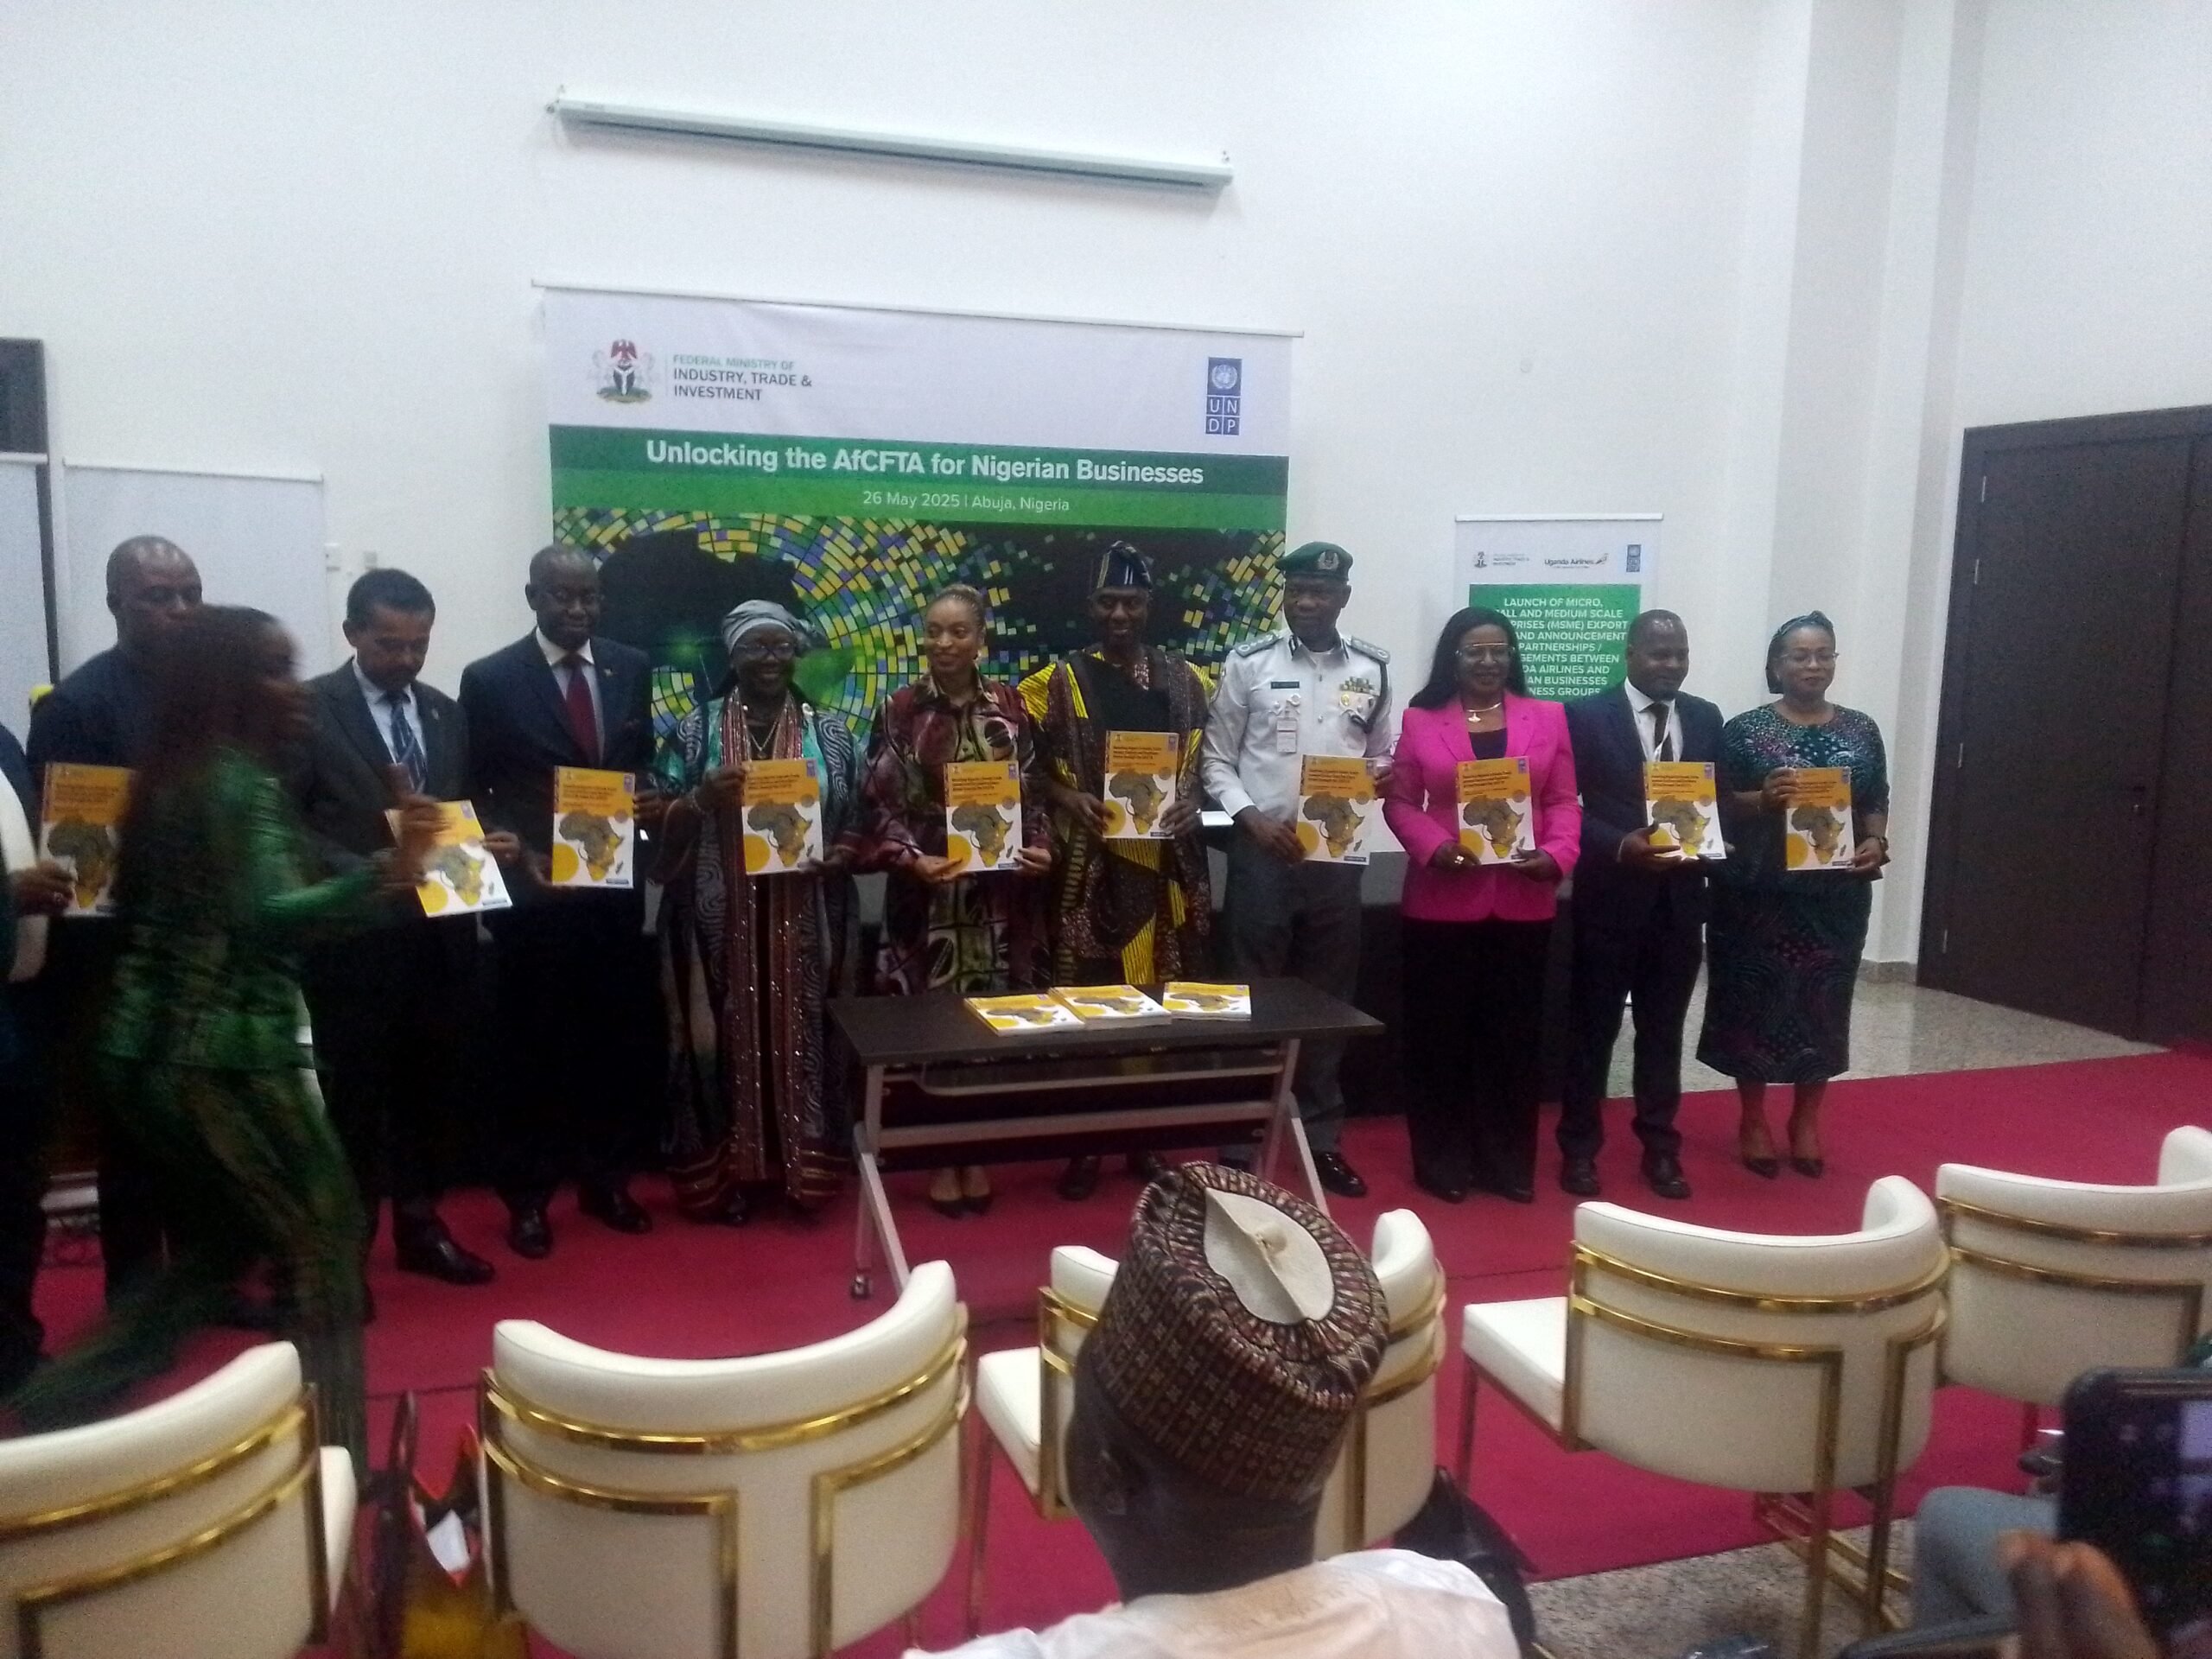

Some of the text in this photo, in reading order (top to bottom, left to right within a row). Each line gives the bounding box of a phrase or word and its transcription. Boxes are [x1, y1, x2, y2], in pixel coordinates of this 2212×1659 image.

[673, 354, 795, 371] FEDERAL MINISTRY OF
[674, 368, 812, 387] INDUSTRY, TRADE &
[674, 385, 762, 401] INVESTMENT
[646, 440, 1205, 484] Unlocking the AfCFTA for Nigerian Businesses
[863, 491, 882, 505] 26
[887, 492, 917, 509] May
[921, 493, 960, 507] 2025
[972, 495, 1015, 512] Abuja,
[1020, 497, 1070, 513] Nigeria
[1544, 558, 1568, 567] Uganda
[1503, 598, 1604, 607] LAUNCH OF MICRO,
[1496, 609, 1624, 618] ALL AND MEDIUM SCALE
[1510, 620, 1629, 631] PRISES (MSME) EXPORT
[1537, 632, 1627, 640] ANNOUNCEMENT
[1518, 643, 1596, 652] PARTNERSHIPS
[1570, 654, 1619, 663] BETWEEN
[1539, 664, 1584, 674] AIRLINES
[1586, 665, 1610, 674] AND
[1544, 676, 1607, 685] BUSINESSES
[1529, 687, 1555, 696] NESS
